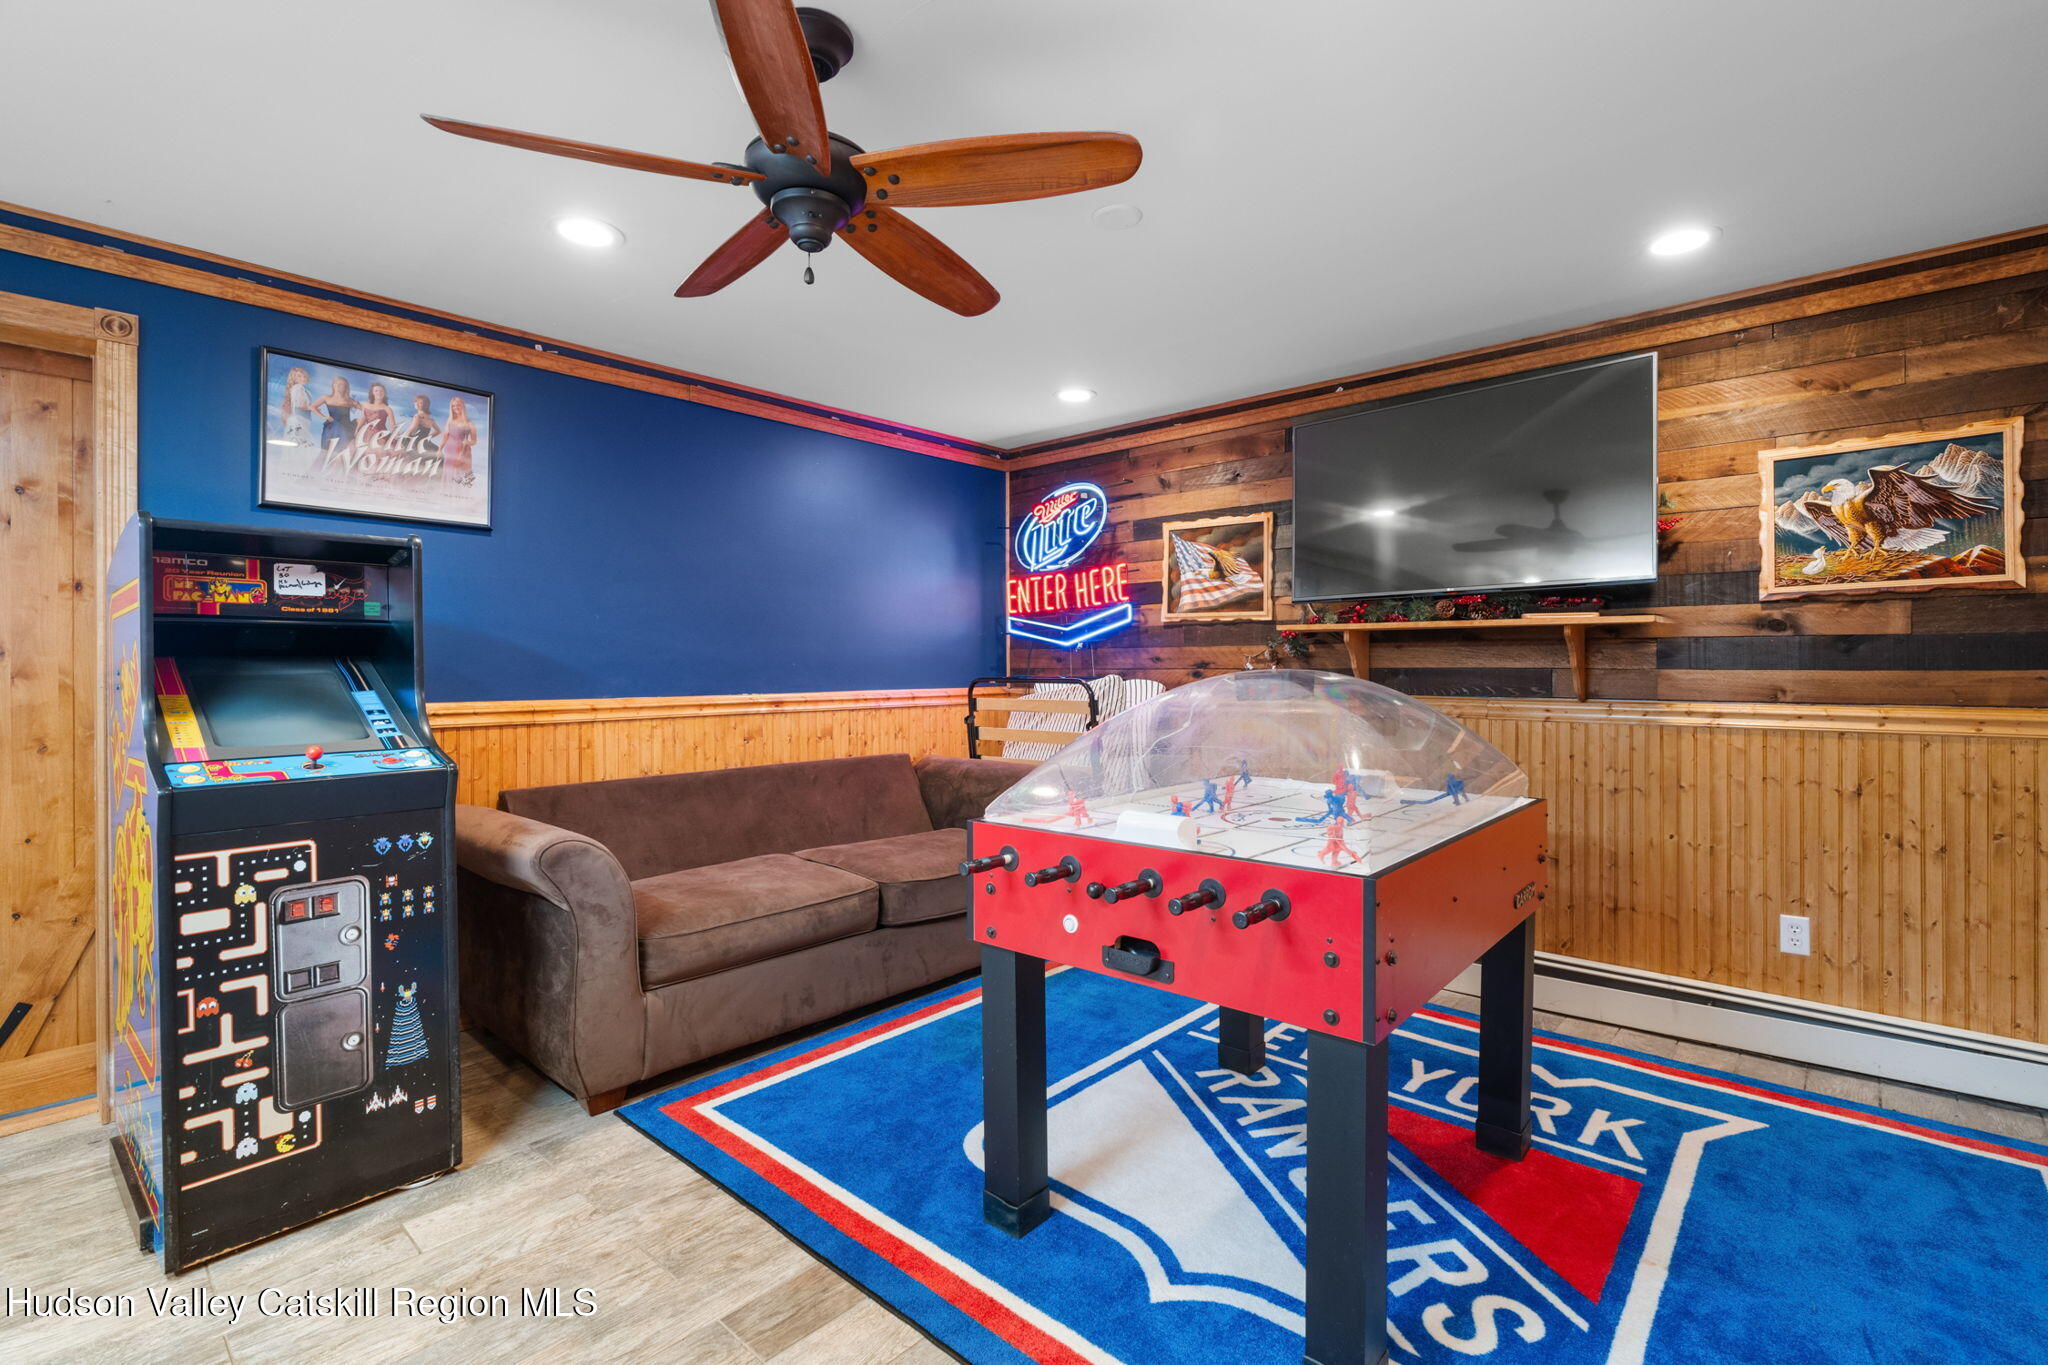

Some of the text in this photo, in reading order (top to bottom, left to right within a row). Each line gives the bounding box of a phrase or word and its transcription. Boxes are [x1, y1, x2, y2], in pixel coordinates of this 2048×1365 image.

[355, 418, 432, 454] Celtic
[321, 437, 442, 479] Woman
[1033, 491, 1078, 524] Miller
[1023, 497, 1098, 570] Lite
[206, 570, 245, 578] Reunion
[1007, 562, 1130, 614] ENTER HERE
